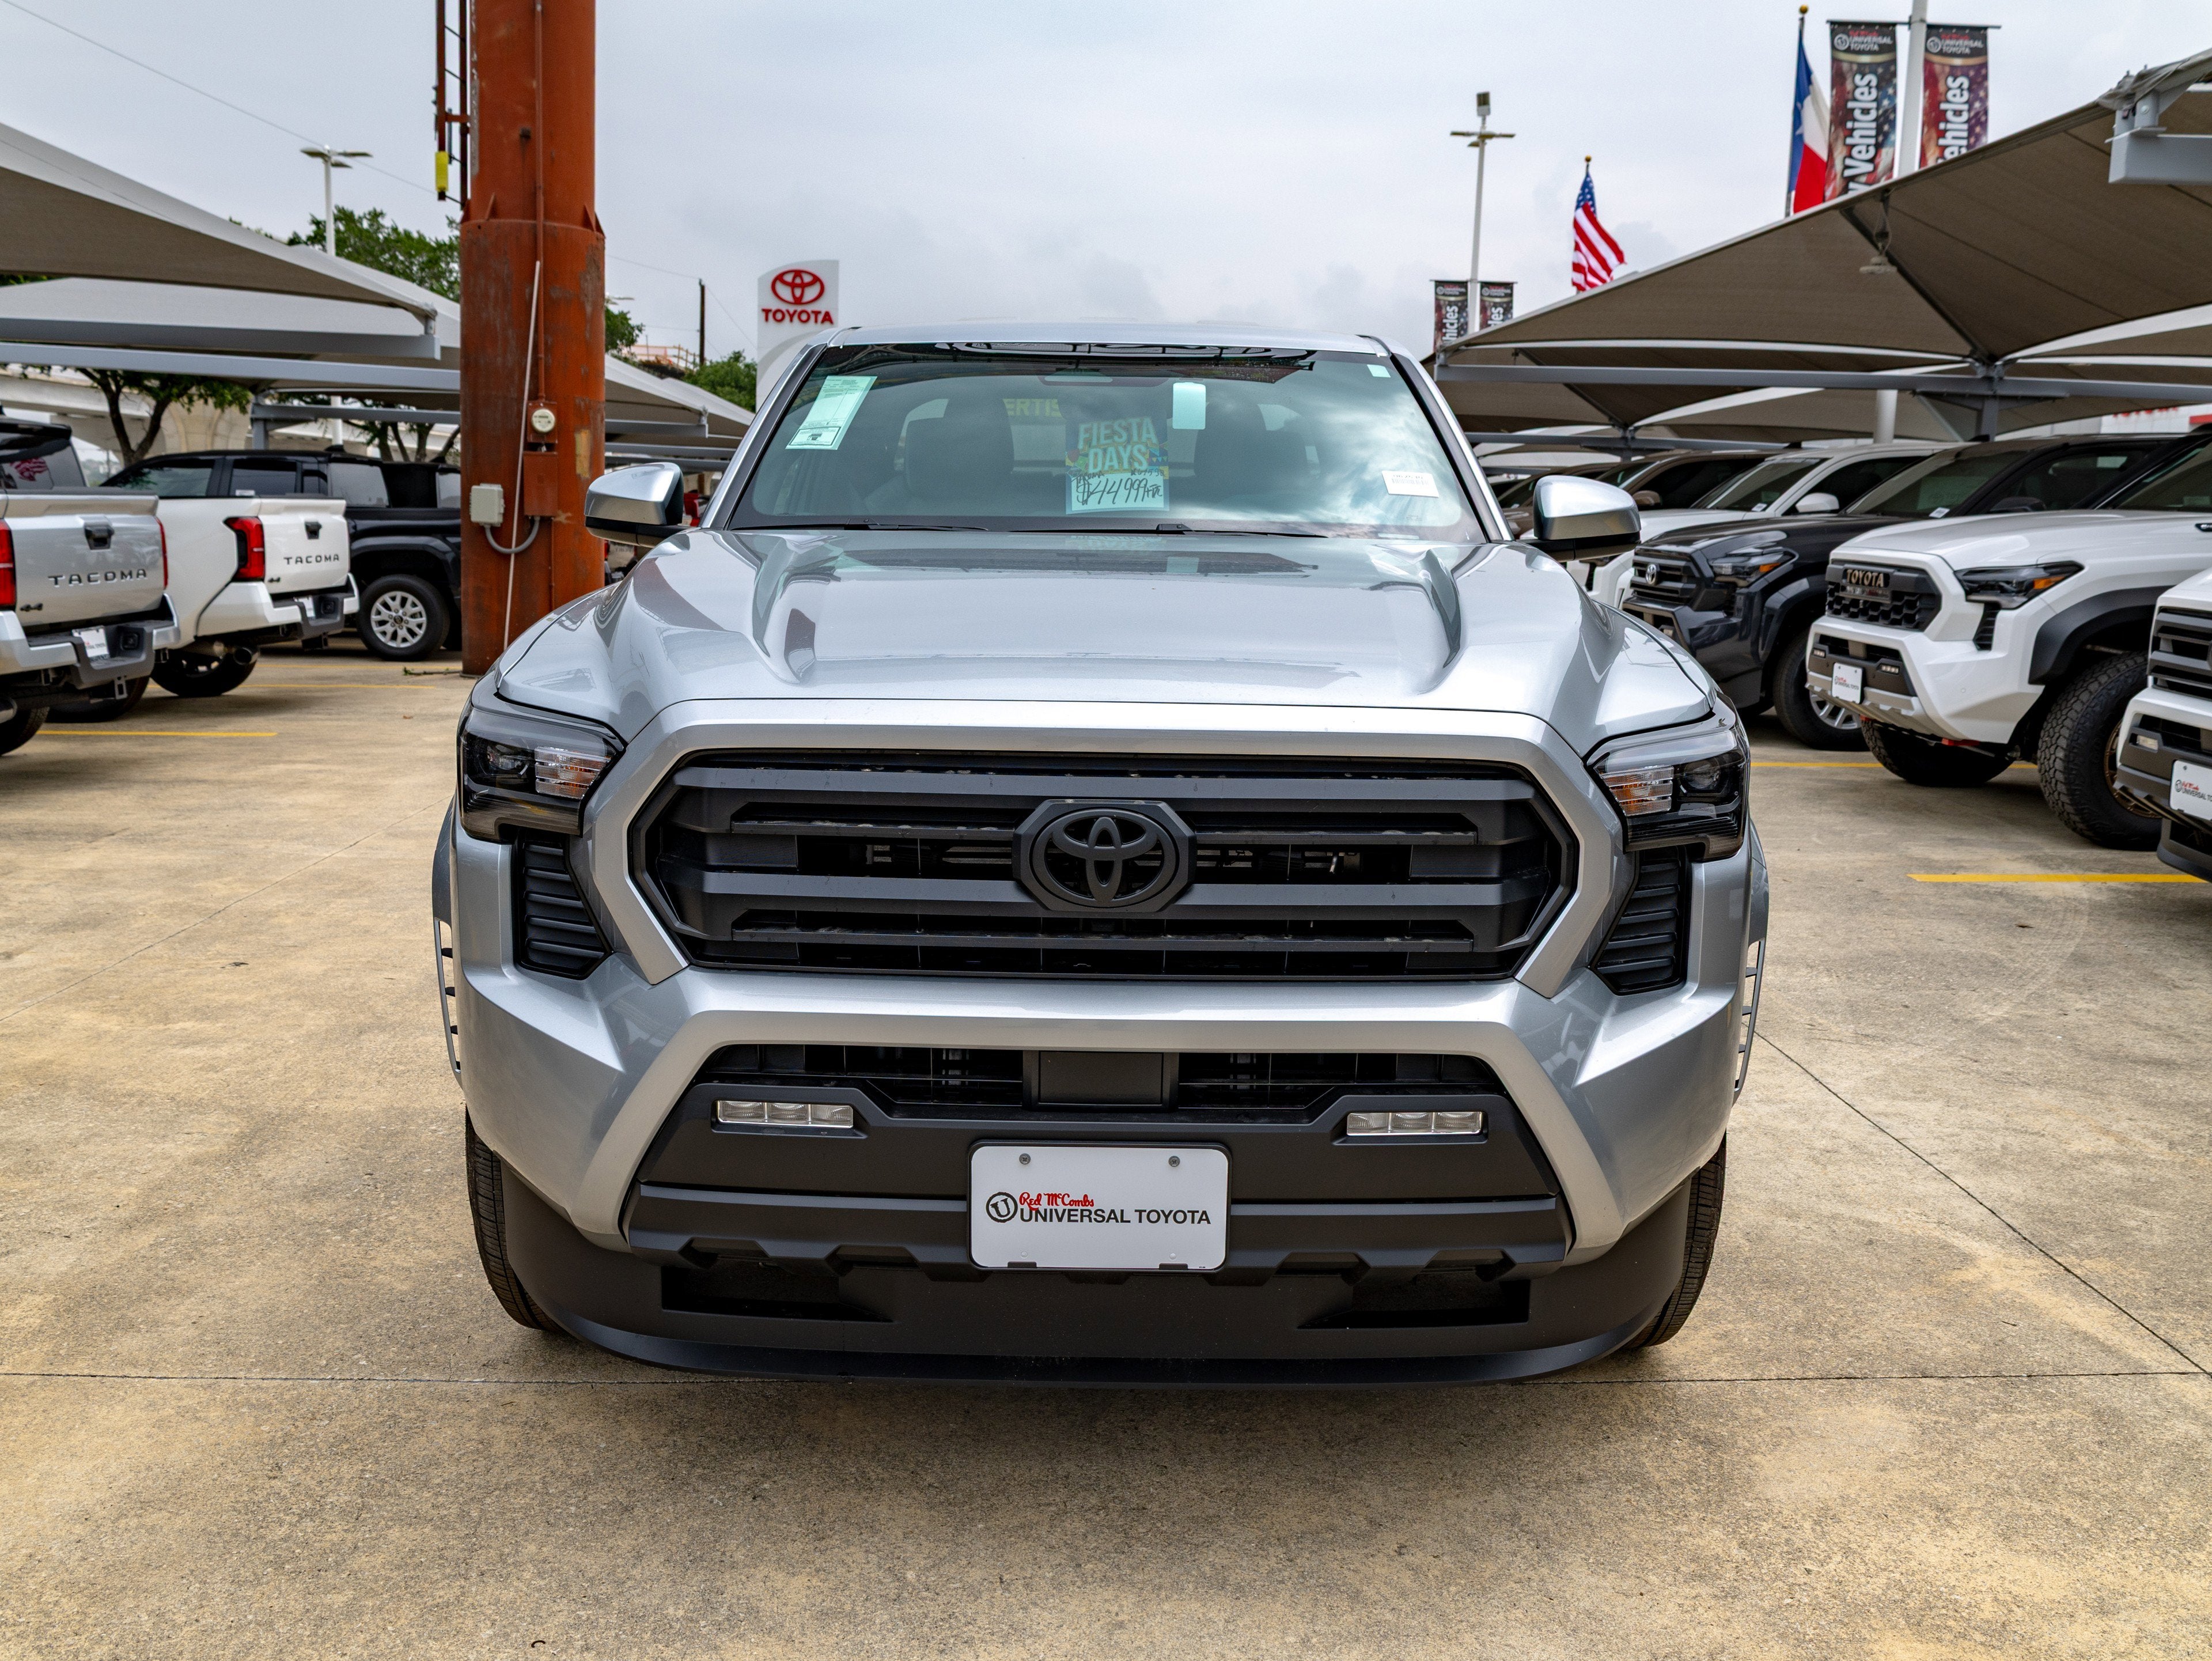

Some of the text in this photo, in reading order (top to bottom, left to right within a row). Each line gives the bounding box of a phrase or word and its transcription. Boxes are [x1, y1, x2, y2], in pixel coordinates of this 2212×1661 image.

[1843, 73, 1878, 177] Vehicles
[1937, 75, 1970, 165] ehicles
[762, 308, 834, 325] TOYOTA
[1078, 417, 1158, 449] FIESTA
[1088, 444, 1149, 473] DAYS
[283, 554, 339, 565] TACOMA
[48, 568, 147, 586] TACOMA
[1846, 569, 1884, 588] TOYOTA
[1019, 1191, 1094, 1210] Red McCombs
[1020, 1208, 1211, 1225] UNIVERSAL TOYOTA
